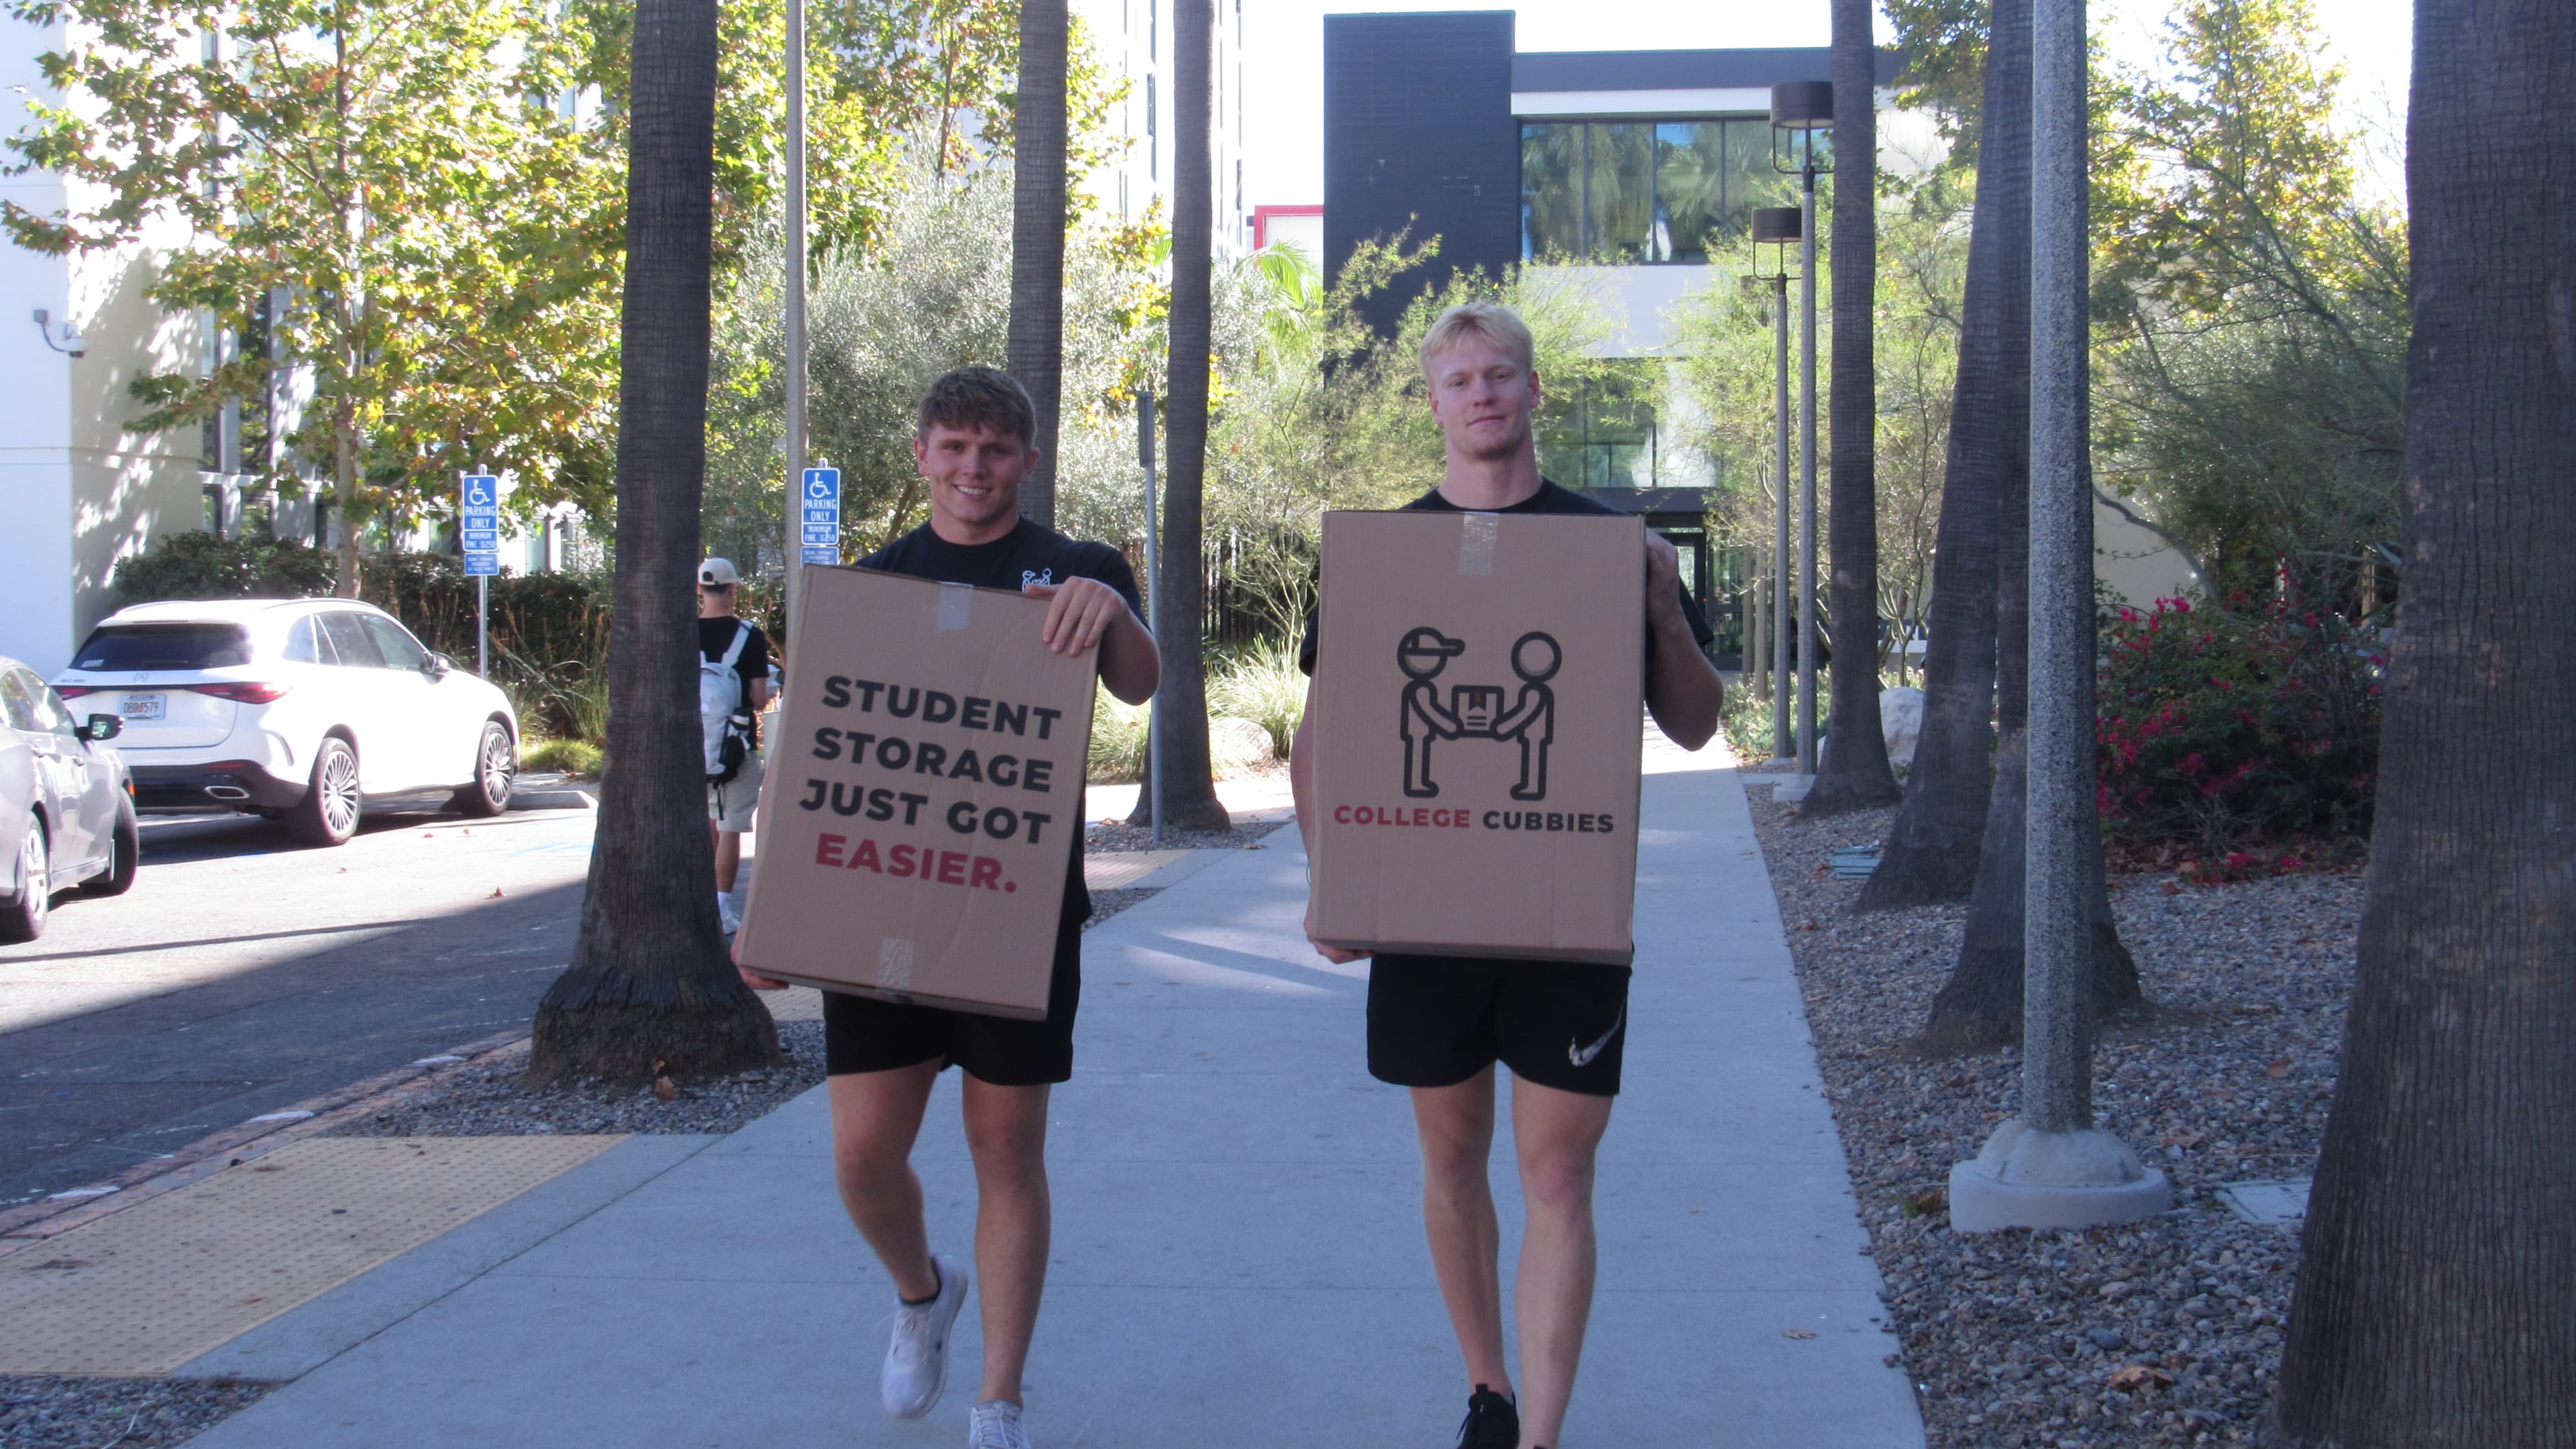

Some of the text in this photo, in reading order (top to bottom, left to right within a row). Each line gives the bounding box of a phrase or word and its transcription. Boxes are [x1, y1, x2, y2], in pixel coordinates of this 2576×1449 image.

[466, 506, 496, 516] PARKING
[805, 499, 837, 509] PARKING
[810, 511, 830, 521] ONLY
[472, 519, 490, 528] ONLY
[822, 676, 1062, 739] STUDENT
[812, 727, 1054, 793] STORAGE
[800, 778, 1052, 844] JUST GOT
[1334, 805, 1614, 833] COLLEGE CUBBIES
[815, 833, 1017, 893] EASIER.
